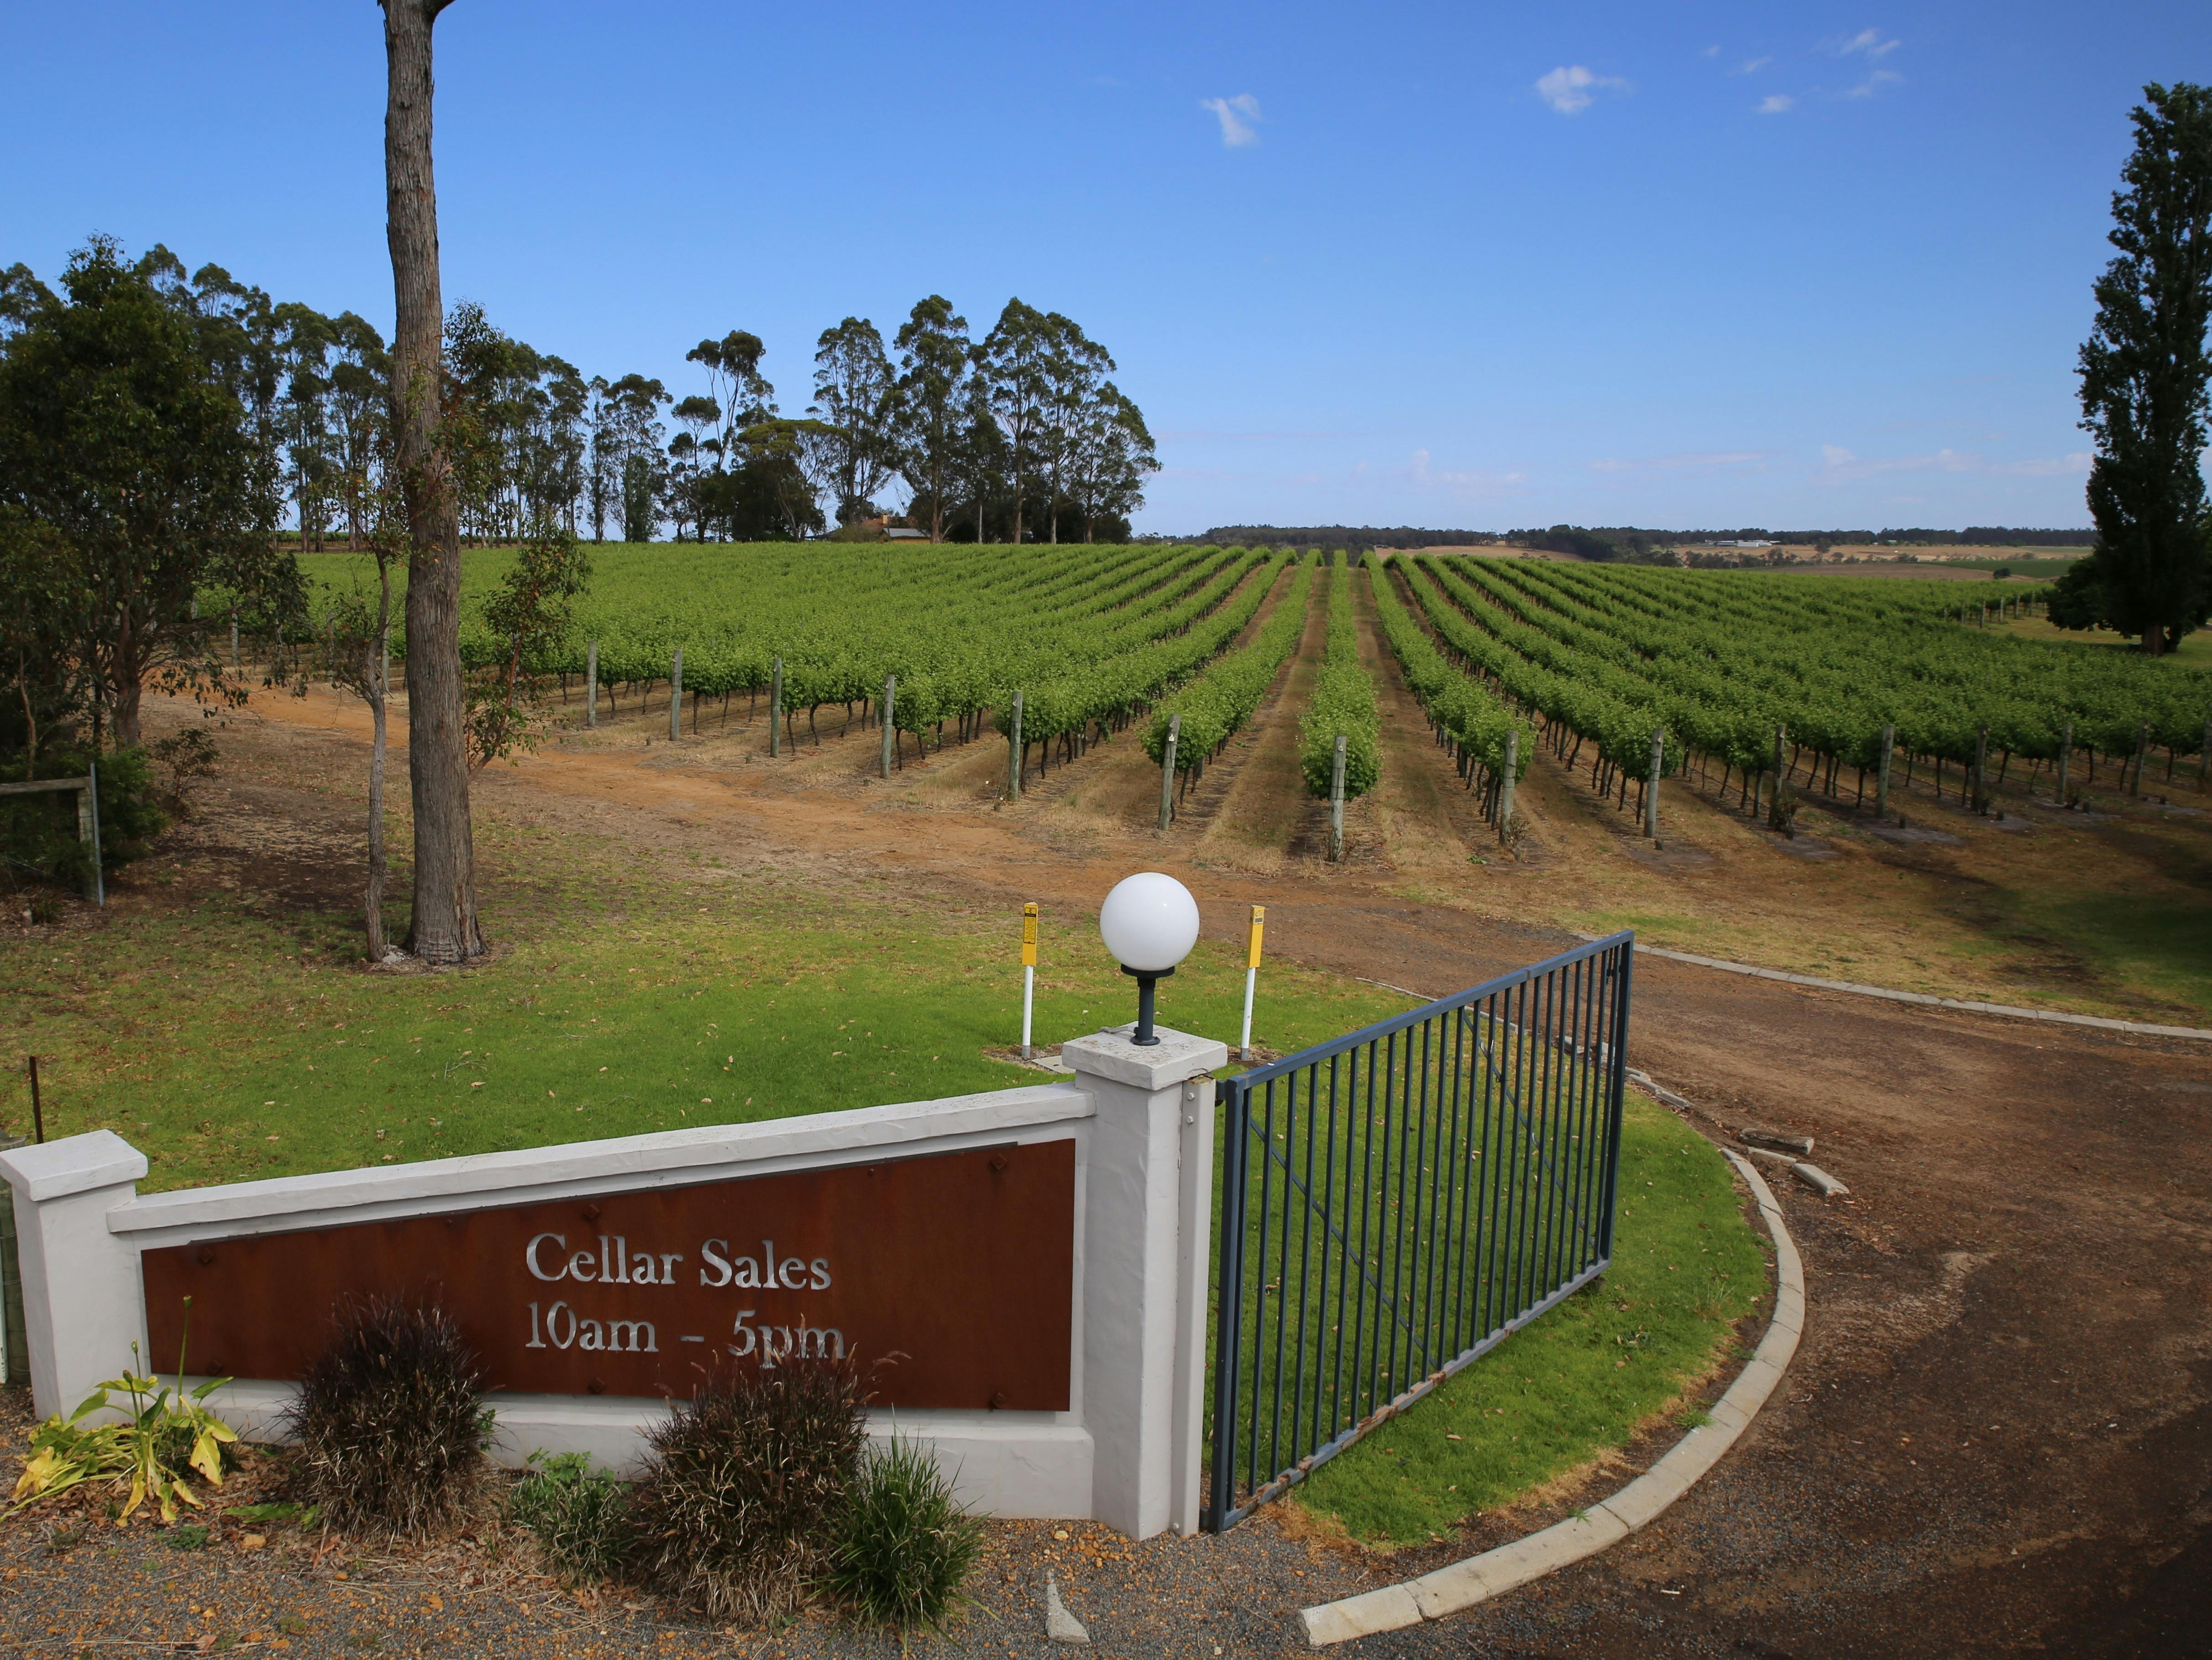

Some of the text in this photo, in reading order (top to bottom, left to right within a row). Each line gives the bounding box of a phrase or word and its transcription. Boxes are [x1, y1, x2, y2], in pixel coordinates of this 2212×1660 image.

[526, 1232, 831, 1290] Cellar Sales
[526, 1300, 659, 1352] 10am
[727, 1309, 846, 1369] 5pm
